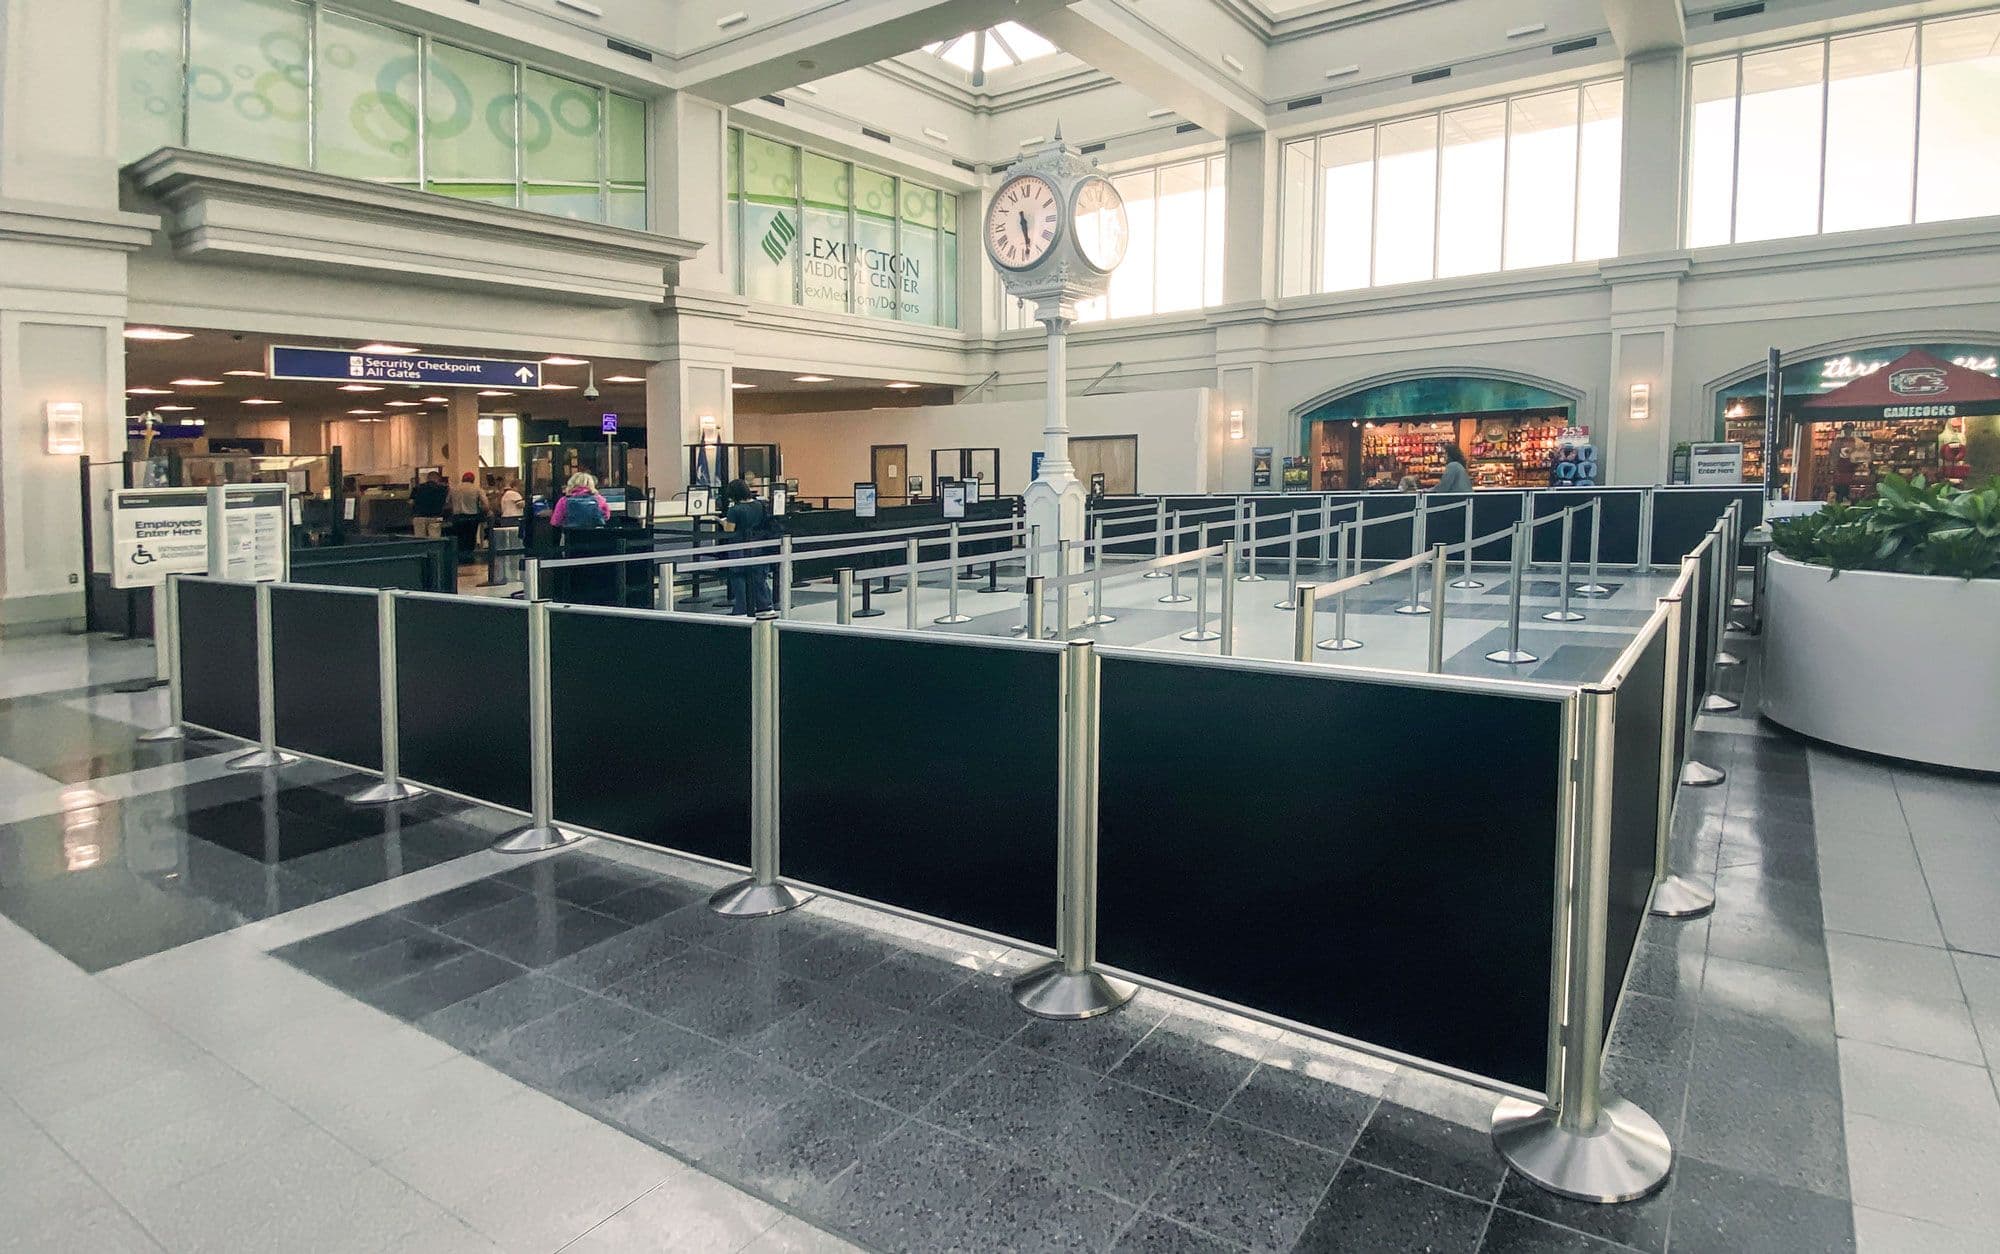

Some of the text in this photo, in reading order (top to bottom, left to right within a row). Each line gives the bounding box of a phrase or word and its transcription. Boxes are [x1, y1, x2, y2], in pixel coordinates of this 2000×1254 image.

[805, 236, 919, 279] EXINGTON
[804, 259, 865, 285] MEDICL
[804, 280, 920, 314] lexMedom/Doors
[366, 357, 481, 373] Security Checkpoint
[366, 367, 421, 379] All Gates
[1821, 356, 1997, 377] thre ers
[1883, 405, 1956, 418] GAMECOCKS
[135, 519, 203, 530] Employees
[136, 528, 202, 538] Enter Here
